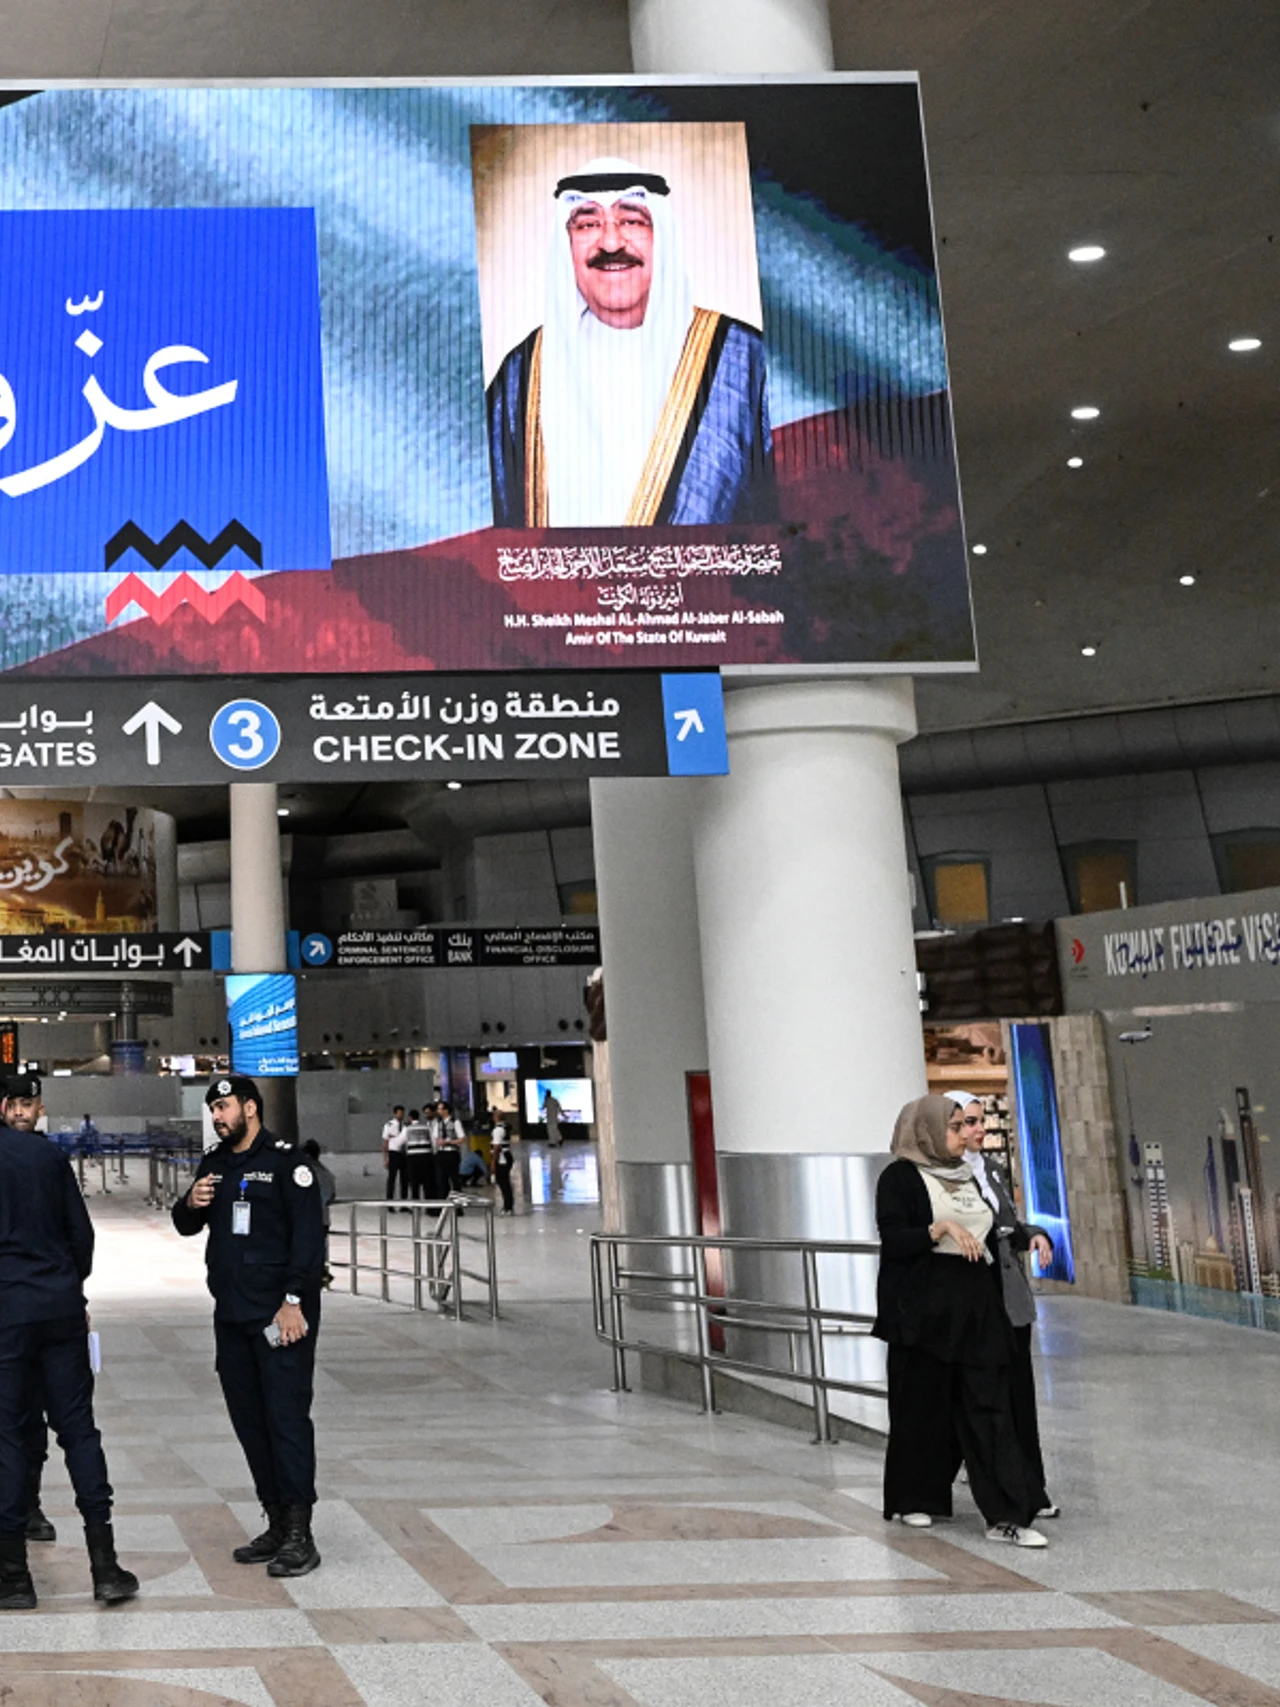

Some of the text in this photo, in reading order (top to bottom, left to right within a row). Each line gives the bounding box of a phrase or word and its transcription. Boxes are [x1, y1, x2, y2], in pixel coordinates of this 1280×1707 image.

[531, 613, 572, 628] Sheikh
[573, 612, 616, 627] Meshal
[731, 610, 785, 625] Al-Sabah
[565, 629, 727, 646] Amir Of The State Of Kuwait
[308, 690, 621, 725] منطقة وزن الأمتعة
[225, 707, 264, 760] 3
[313, 730, 621, 763] CHECK-IN ZONE
[70, 937, 164, 969] بوابات
[447, 949, 473, 963] BANK
[1103, 927, 1165, 977] KUWAIT
[1169, 917, 1241, 971] FUTURE
